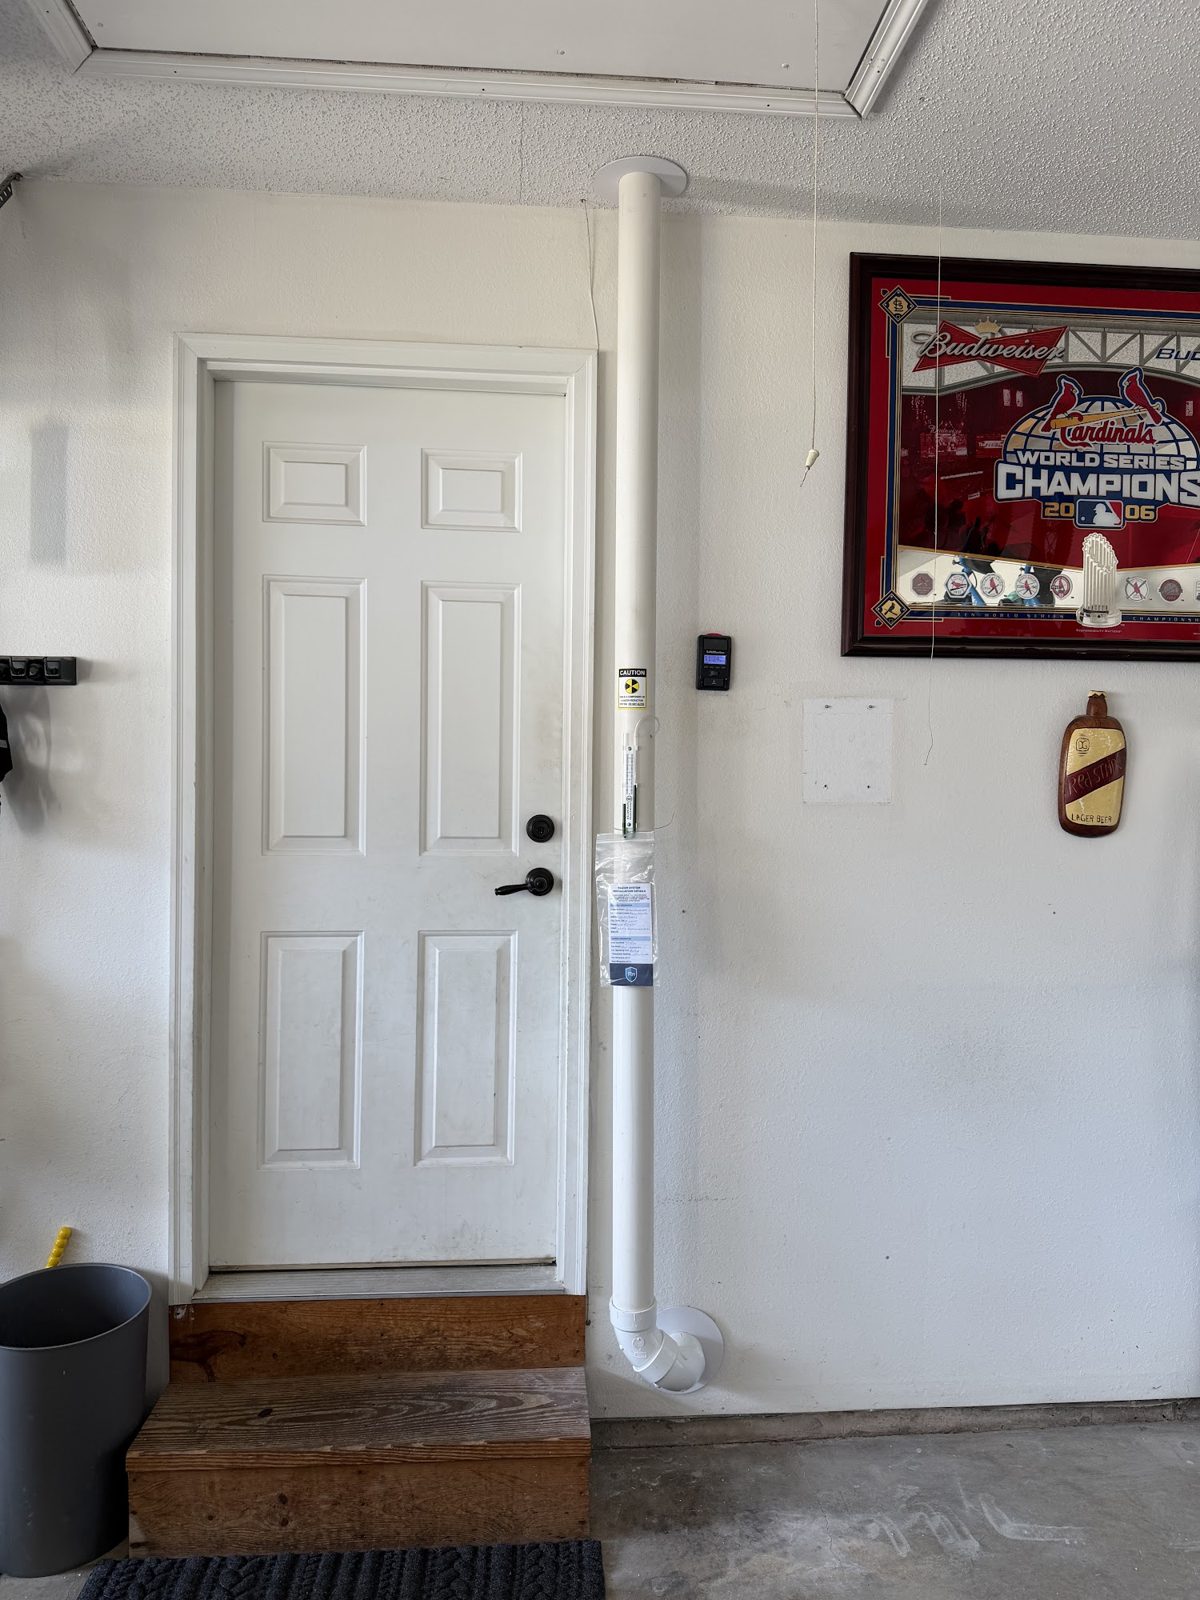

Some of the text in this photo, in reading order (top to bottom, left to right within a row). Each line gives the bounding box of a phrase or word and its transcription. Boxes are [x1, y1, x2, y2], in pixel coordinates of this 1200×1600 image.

[912, 330, 1064, 360] Budweiser
[1060, 412, 1158, 448] Cardinals
[1017, 450, 1185, 471] WORLD SERIES
[998, 464, 1200, 507] CHAMPIONS
[1044, 502, 1155, 520] 20 06
[1071, 813, 1112, 824] LAGER BEER
